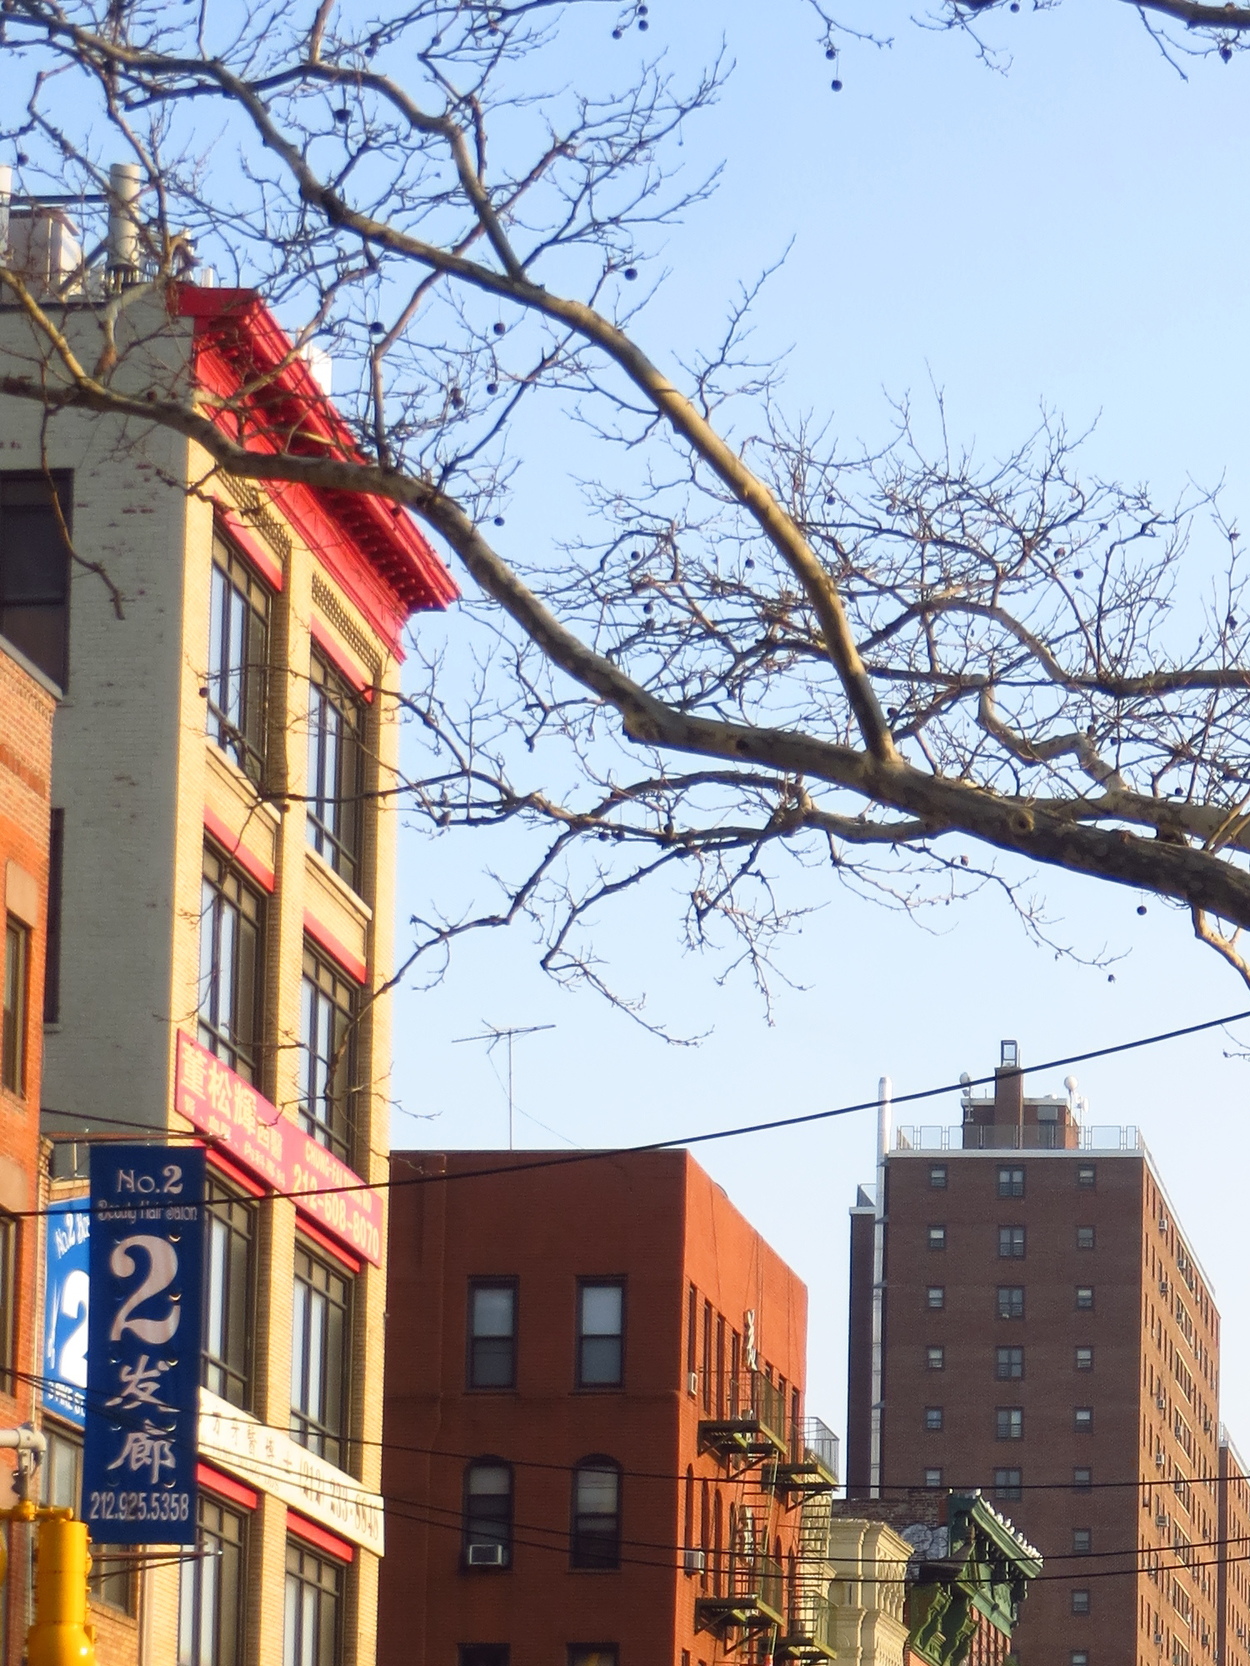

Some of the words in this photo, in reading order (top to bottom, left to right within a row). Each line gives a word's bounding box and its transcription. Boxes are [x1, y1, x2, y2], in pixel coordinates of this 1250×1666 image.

[116, 1165, 183, 1194] No.2
[98, 1200, 136, 1224] Beauty
[140, 1201, 163, 1221] Hair
[165, 1200, 198, 1221] Salon
[294, 1163, 380, 1259] 212-608-8070
[90, 1491, 189, 1521] 212.925.5358
